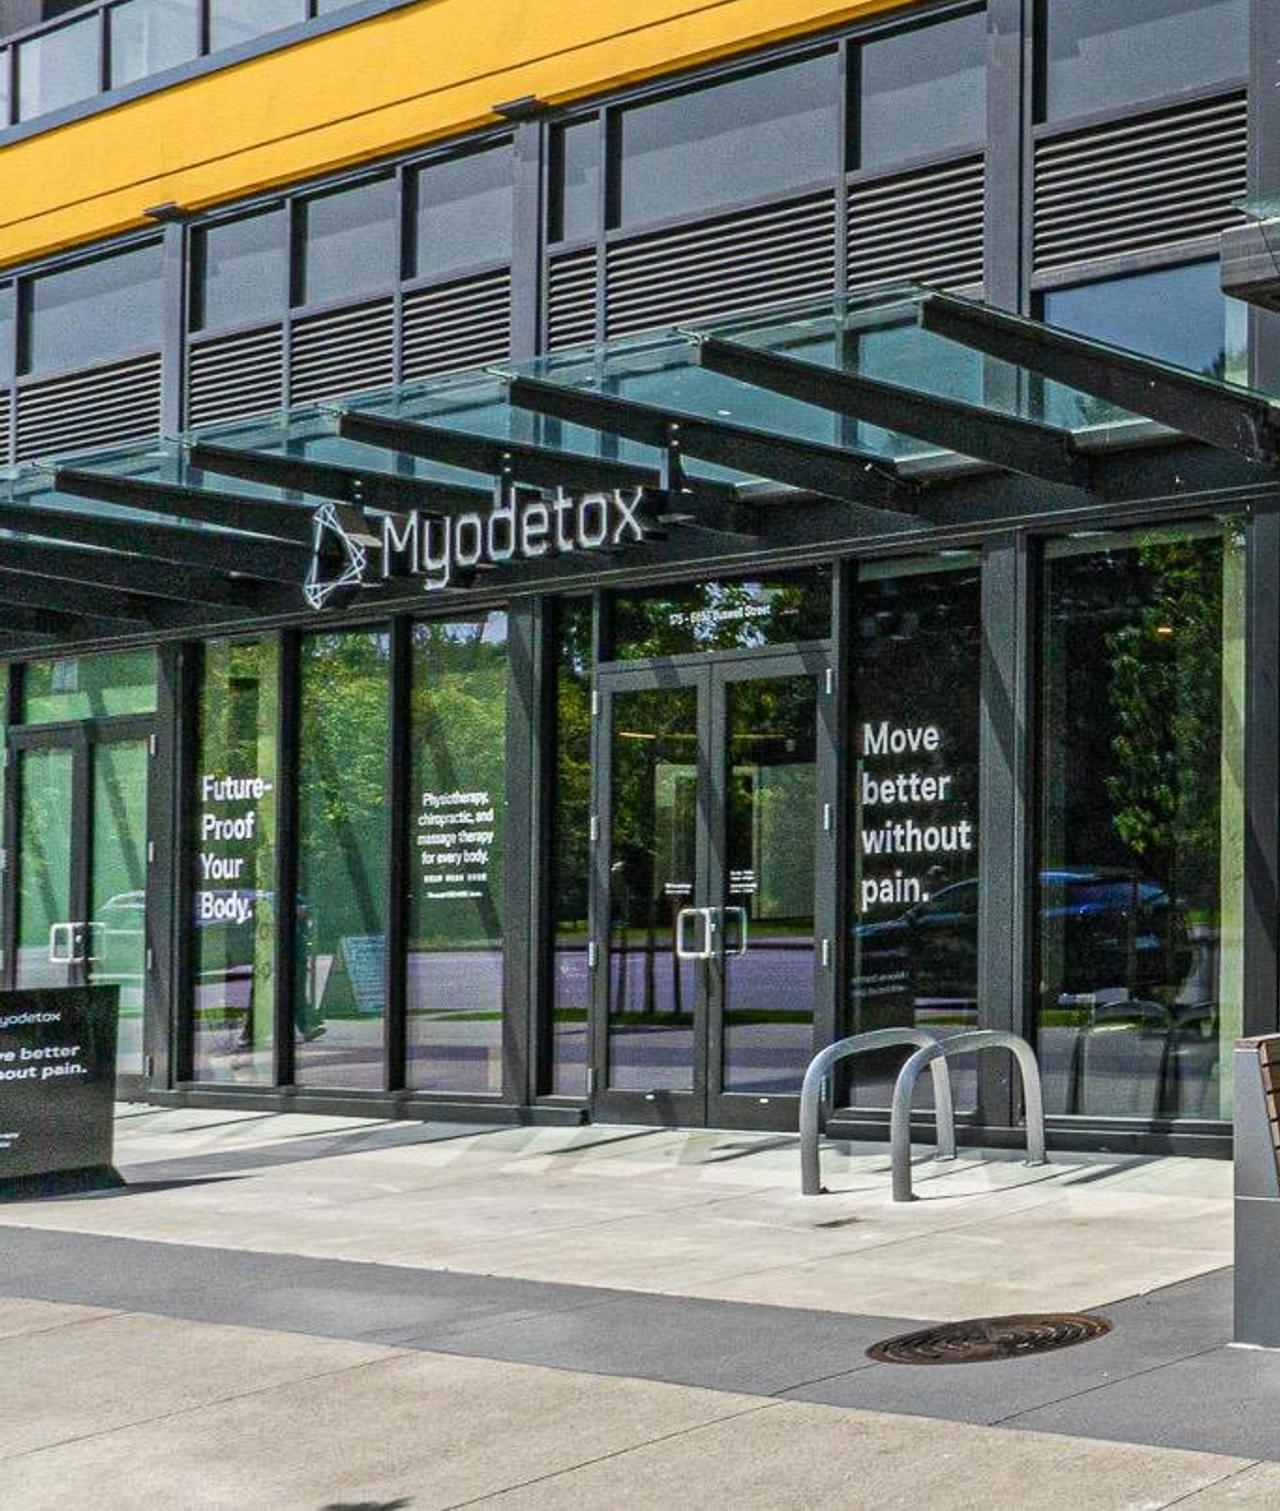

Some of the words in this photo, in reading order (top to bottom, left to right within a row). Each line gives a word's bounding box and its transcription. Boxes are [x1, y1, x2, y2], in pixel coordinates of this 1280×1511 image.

[383, 485, 643, 590] Myodetox
[862, 721, 940, 756] Move
[202, 774, 272, 802] Future-
[862, 772, 951, 805] better
[201, 811, 254, 840] Proof
[458, 830, 495, 844] therapy
[861, 819, 972, 854] without
[200, 853, 244, 880] Your
[422, 851, 435, 865] for
[436, 852, 462, 866] every
[463, 849, 489, 865] body.
[861, 869, 931, 913] pain.
[200, 890, 253, 925] Body.
[0, 1012, 61, 1028] yodetox
[20, 1045, 80, 1060] better
[41, 1062, 87, 1080] pain.
